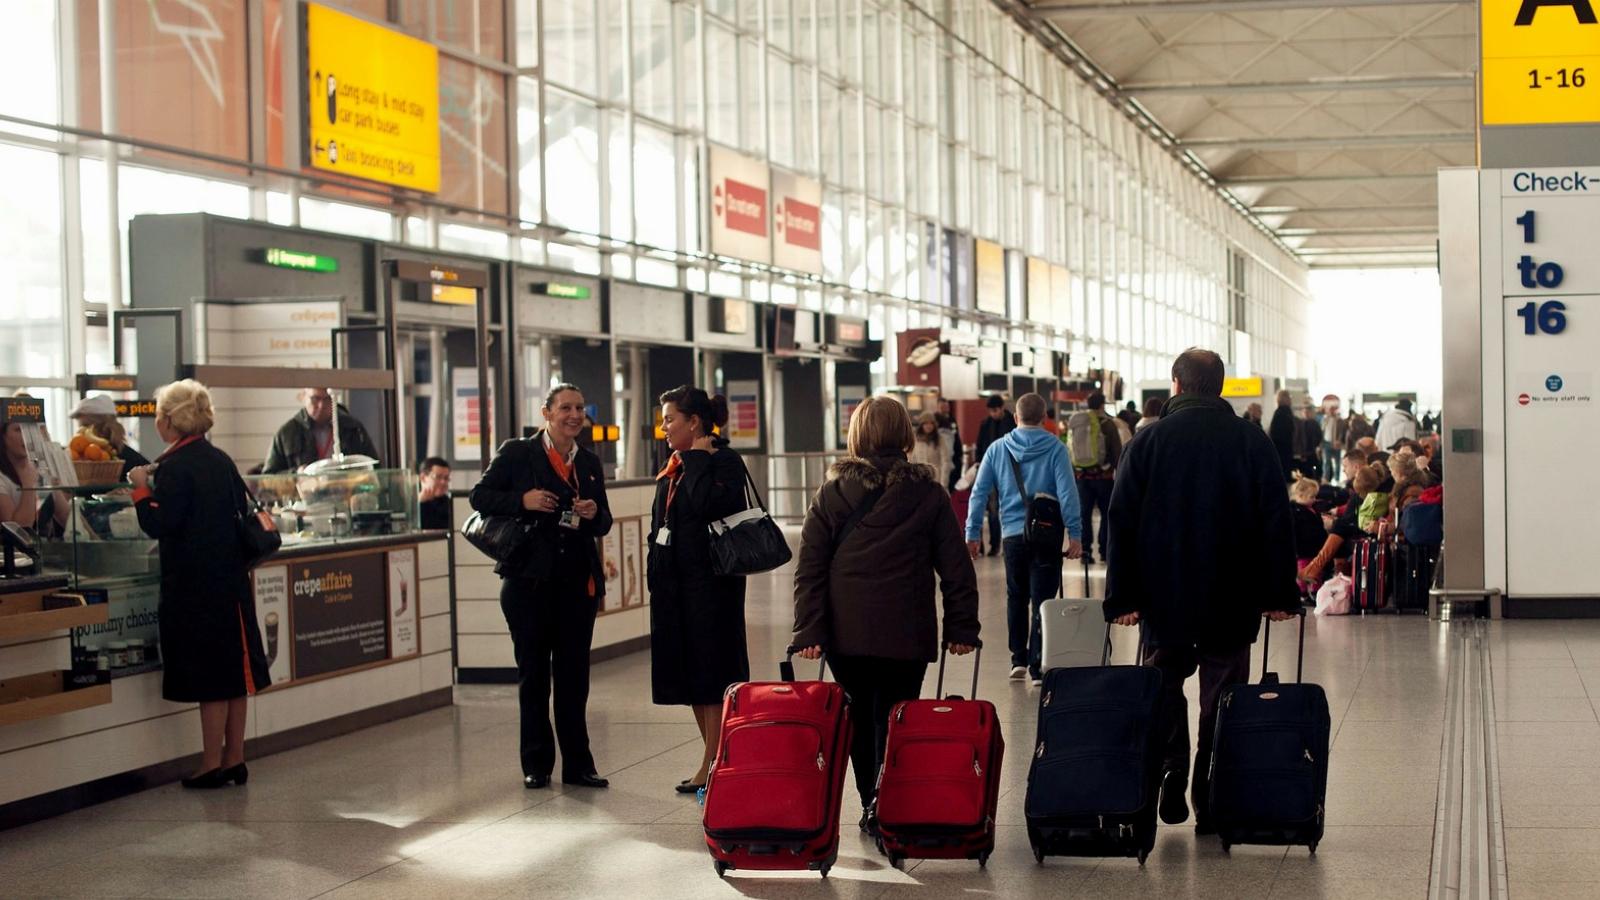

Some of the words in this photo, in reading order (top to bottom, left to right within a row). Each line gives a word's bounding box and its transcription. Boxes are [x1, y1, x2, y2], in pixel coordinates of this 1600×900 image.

[1528, 68, 1586, 89] 1-16
[1516, 210, 1535, 243] 1
[1517, 255, 1564, 289] to
[1517, 300, 1567, 336] 16
[7, 403, 41, 419] pick-up
[1577, 395, 1591, 403] only
